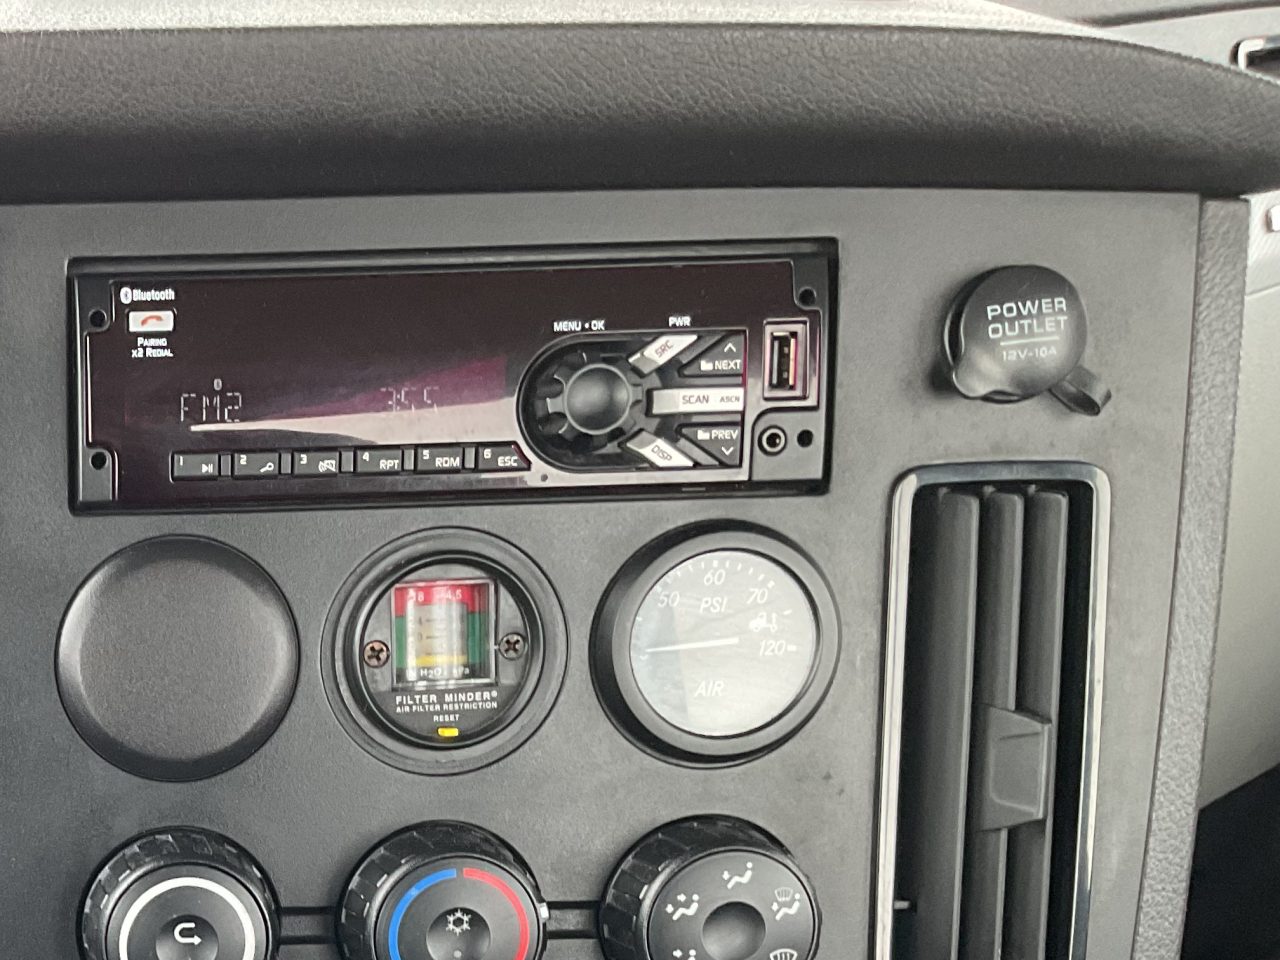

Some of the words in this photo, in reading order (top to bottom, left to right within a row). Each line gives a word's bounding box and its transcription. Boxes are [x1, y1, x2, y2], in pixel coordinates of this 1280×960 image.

[132, 288, 175, 301] Bluetooth
[986, 297, 1067, 321] POWER
[553, 320, 582, 332] MENU
[591, 319, 605, 331] OK
[668, 316, 691, 327] PWR
[988, 316, 1068, 339] OUTLET
[654, 340, 673, 357] SRC
[1002, 346, 1057, 361] 12V-10A
[714, 360, 741, 370] NEXT
[180, 392, 242, 423] FM2
[682, 395, 710, 405] SCAN
[711, 429, 738, 440] PREV
[239, 454, 247, 465] 2
[300, 453, 307, 464] 3
[362, 451, 370, 462] 4
[379, 459, 399, 470] RPT
[422, 450, 430, 460] 5
[435, 457, 460, 467] RDM
[483, 448, 492, 459] 6
[497, 456, 518, 467] ESC
[651, 444, 672, 461] DISP
[703, 569, 726, 586] 60
[657, 591, 680, 608] 50
[746, 588, 769, 604] 70
[700, 596, 728, 613] PSI
[759, 640, 786, 656] 120
[694, 680, 725, 697] AIR
[395, 694, 437, 706] FILTER
[396, 705, 410, 713] AIR
[412, 704, 440, 712] FILTER
[443, 701, 498, 711] RESTRICTION
[433, 713, 460, 722] RESET
